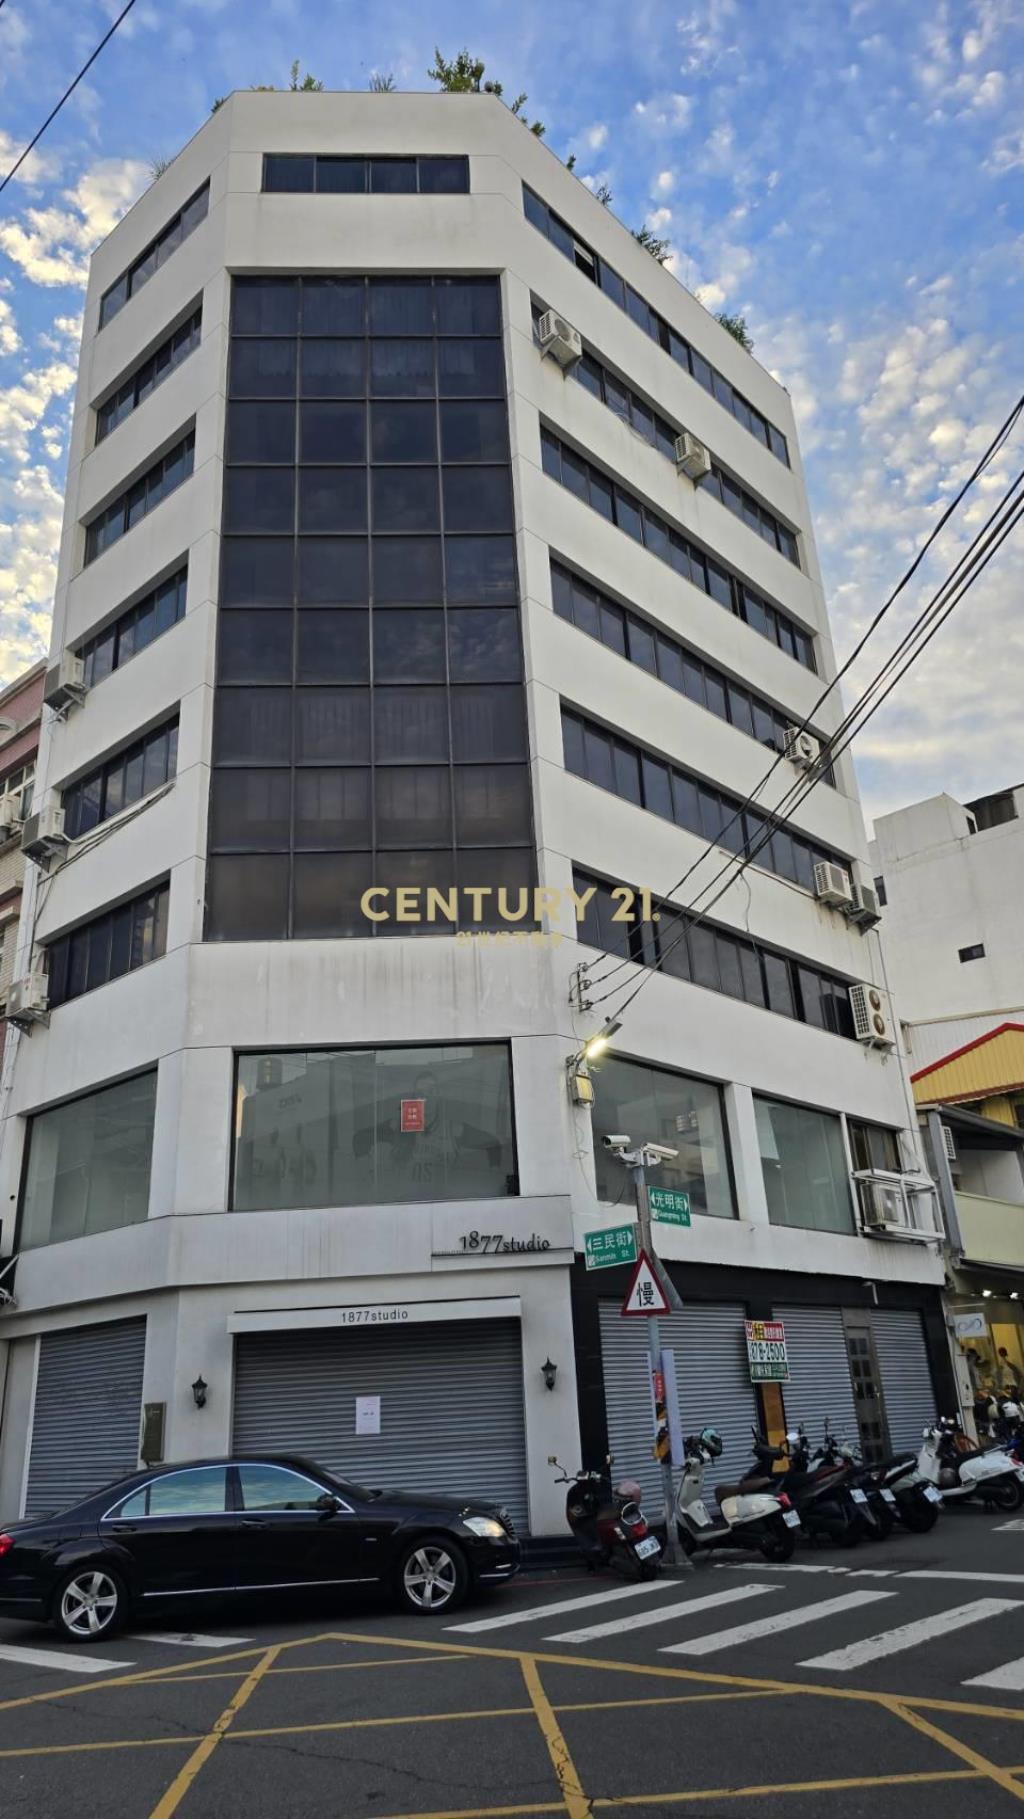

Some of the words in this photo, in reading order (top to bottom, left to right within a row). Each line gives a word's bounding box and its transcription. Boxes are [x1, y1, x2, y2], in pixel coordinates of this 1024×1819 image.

[655, 1192, 684, 1210] 光明街
[459, 1230, 550, 1254] 1877studio
[592, 1231, 627, 1250] 三民街
[636, 1281, 654, 1307] 慢
[341, 1309, 408, 1323] 1877studio
